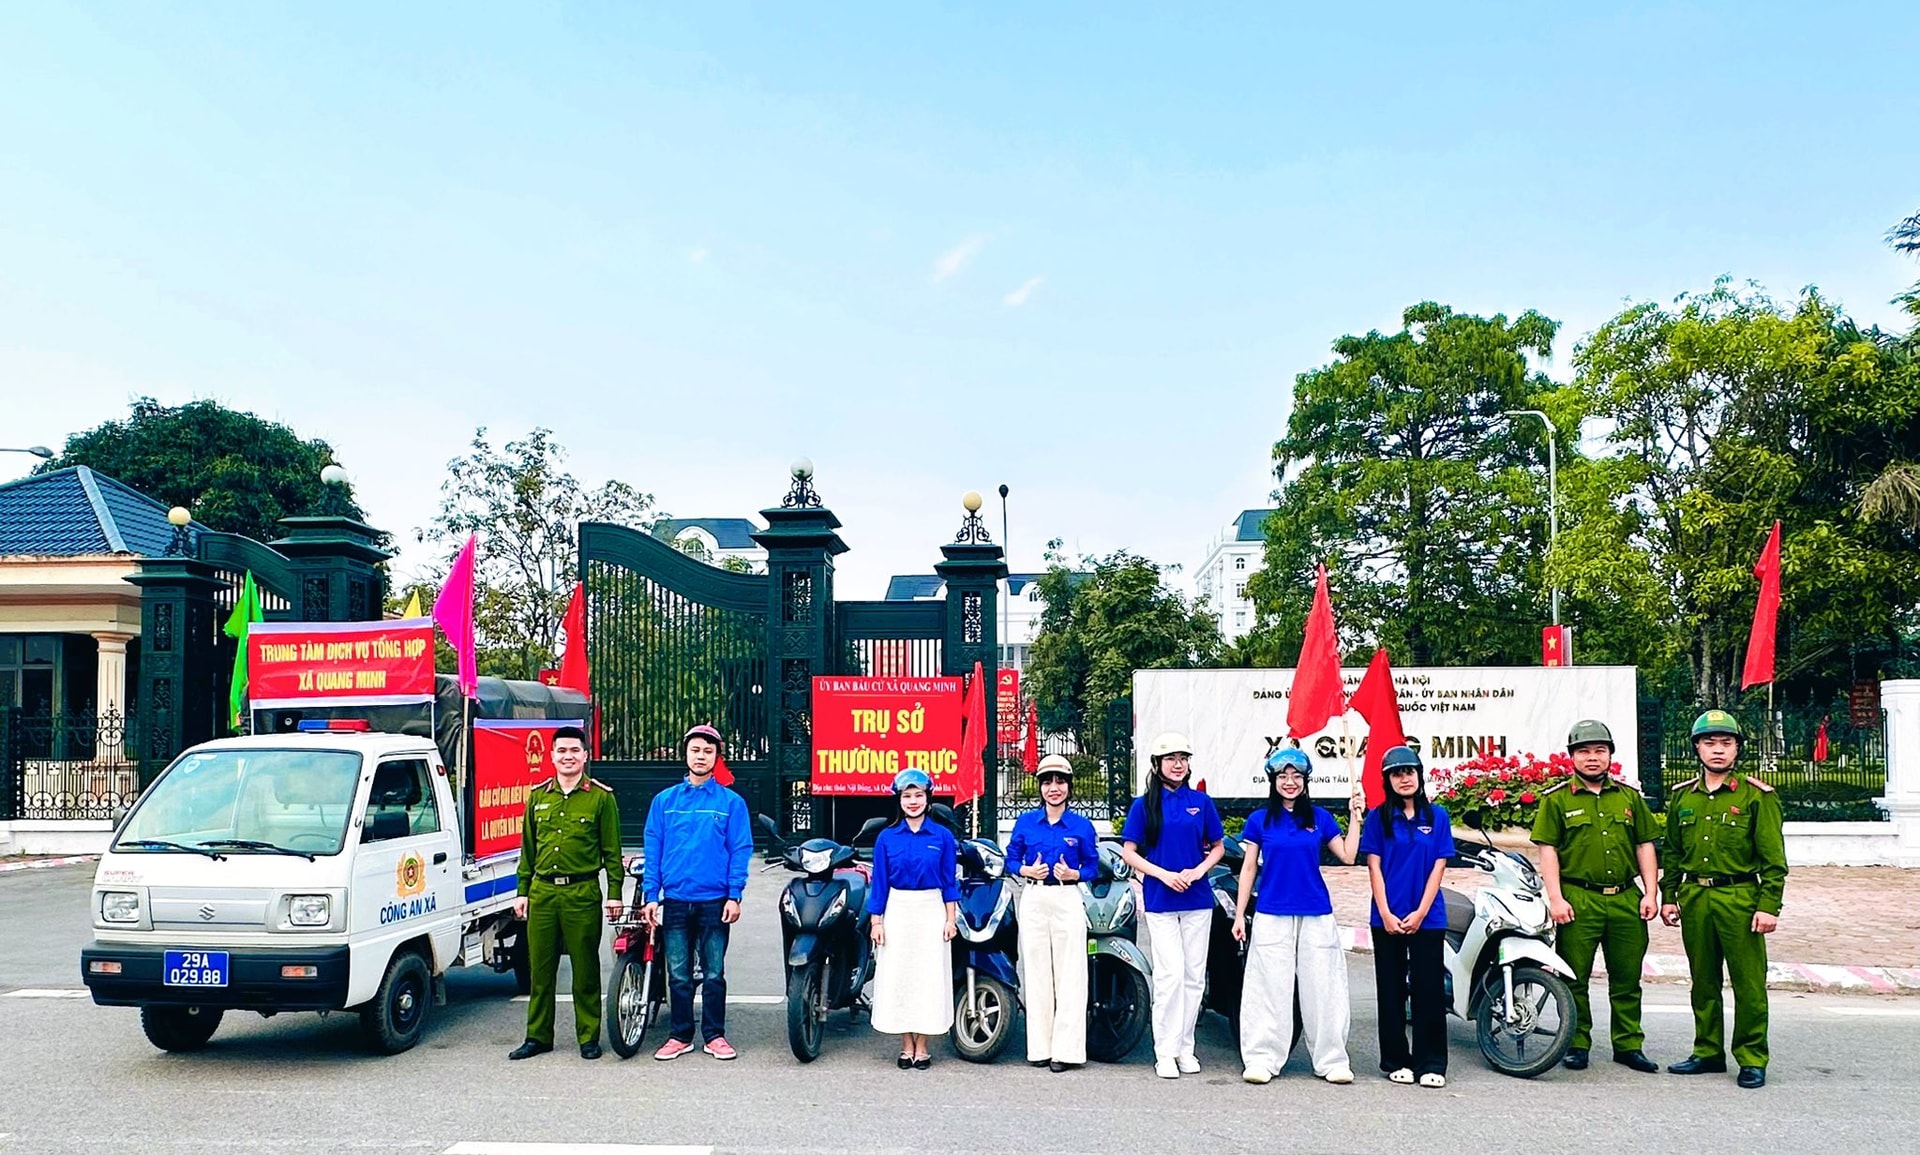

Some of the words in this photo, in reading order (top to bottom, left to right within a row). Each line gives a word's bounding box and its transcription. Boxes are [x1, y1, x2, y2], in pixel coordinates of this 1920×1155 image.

[259, 644, 298, 662] TRUNG
[300, 640, 324, 661] TÂM
[327, 642, 353, 664] DỊCH
[355, 641, 370, 663] VỤ
[372, 634, 401, 659] TỔNG
[404, 638, 426, 660] HỢP
[298, 669, 314, 690] XÃ
[316, 671, 353, 692] QUANG
[356, 670, 387, 689] MINH
[833, 681, 851, 691] BAN
[886, 679, 899, 692] XÃ
[900, 681, 931, 694] QUANG
[932, 681, 957, 692] MINH
[1437, 689, 1457, 698] BAN
[1461, 688, 1489, 698] NHÂN
[1452, 703, 1476, 712] NAM
[851, 709, 890, 738] TRỤ
[896, 702, 925, 734] SỞ
[1431, 735, 1507, 759] MINH
[816, 744, 899, 774] THƯỜNG
[905, 747, 958, 779] TRỰC
[1307, 775, 1331, 784] RUNG
[380, 901, 407, 925] CÔNG
[409, 899, 422, 917] AN
[424, 892, 436, 914] XÃ
[182, 953, 210, 969] 29A
[171, 969, 221, 984] 029.88
